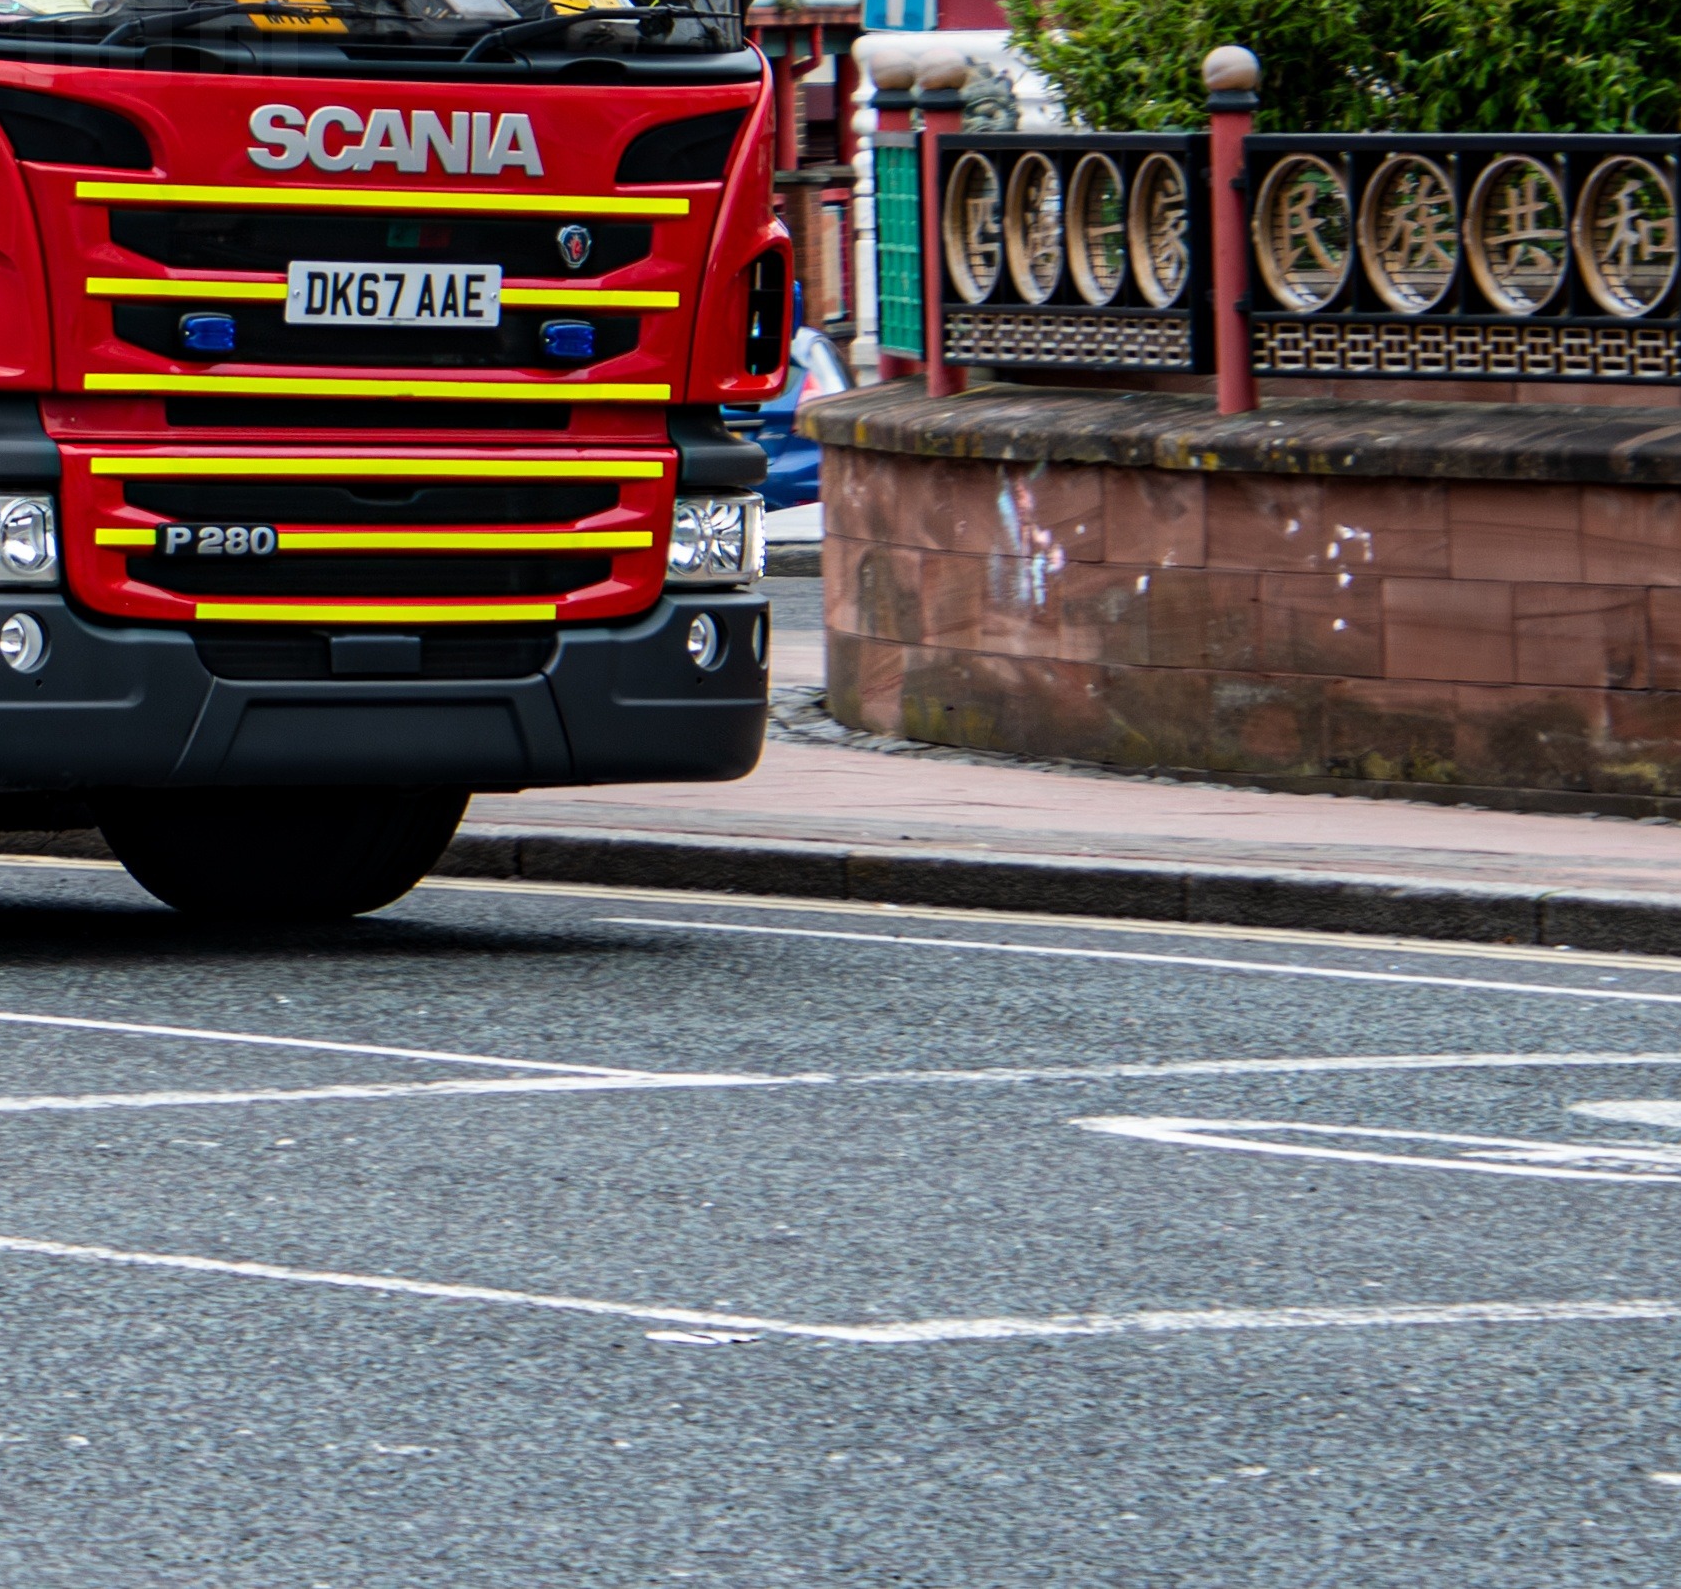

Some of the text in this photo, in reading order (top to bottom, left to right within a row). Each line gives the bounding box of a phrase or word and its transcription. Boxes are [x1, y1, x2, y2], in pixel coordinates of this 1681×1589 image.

[247, 103, 545, 177] SCANIA
[304, 271, 487, 318] DK67 AAE
[165, 526, 275, 555] P 280
